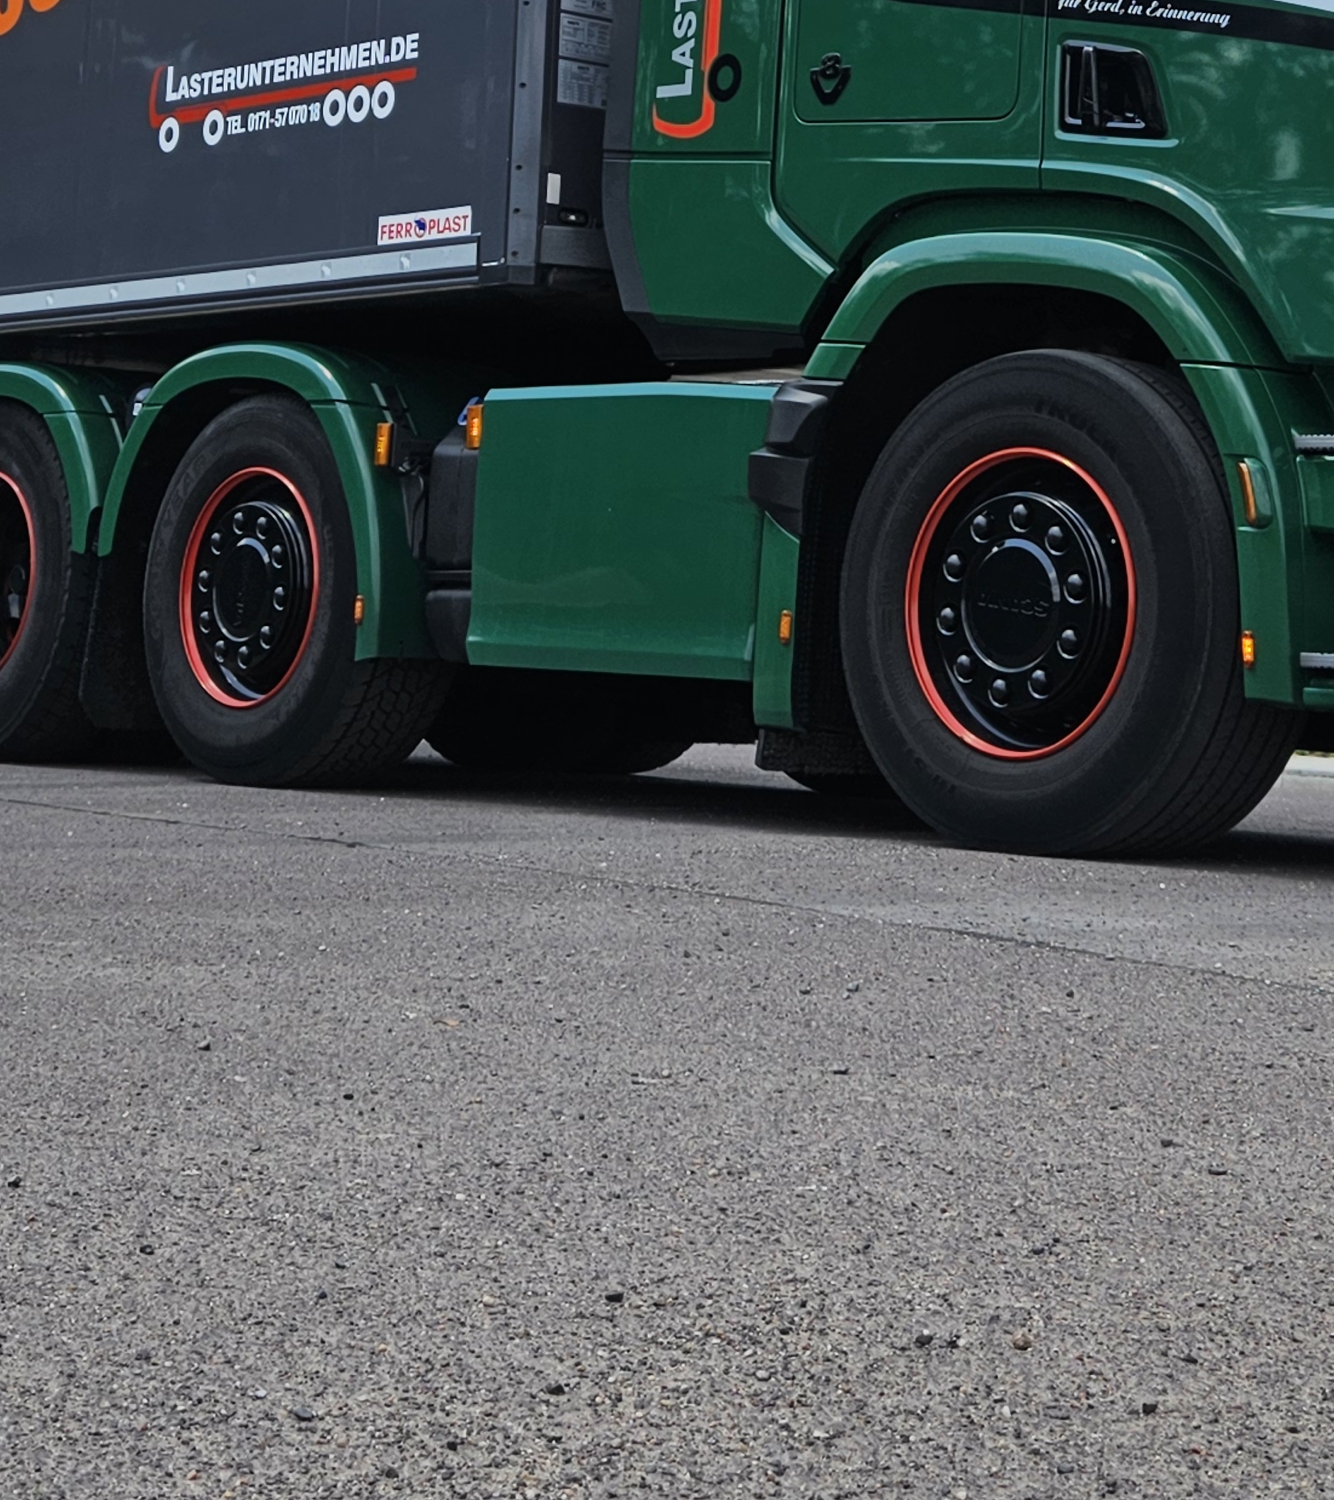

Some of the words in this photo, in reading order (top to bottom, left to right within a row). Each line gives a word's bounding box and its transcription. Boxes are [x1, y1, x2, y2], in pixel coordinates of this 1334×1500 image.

[1127, 0, 1143, 15] in
[1145, 0, 1231, 28] Erinnerung
[379, 214, 470, 241] FERROPLAST
